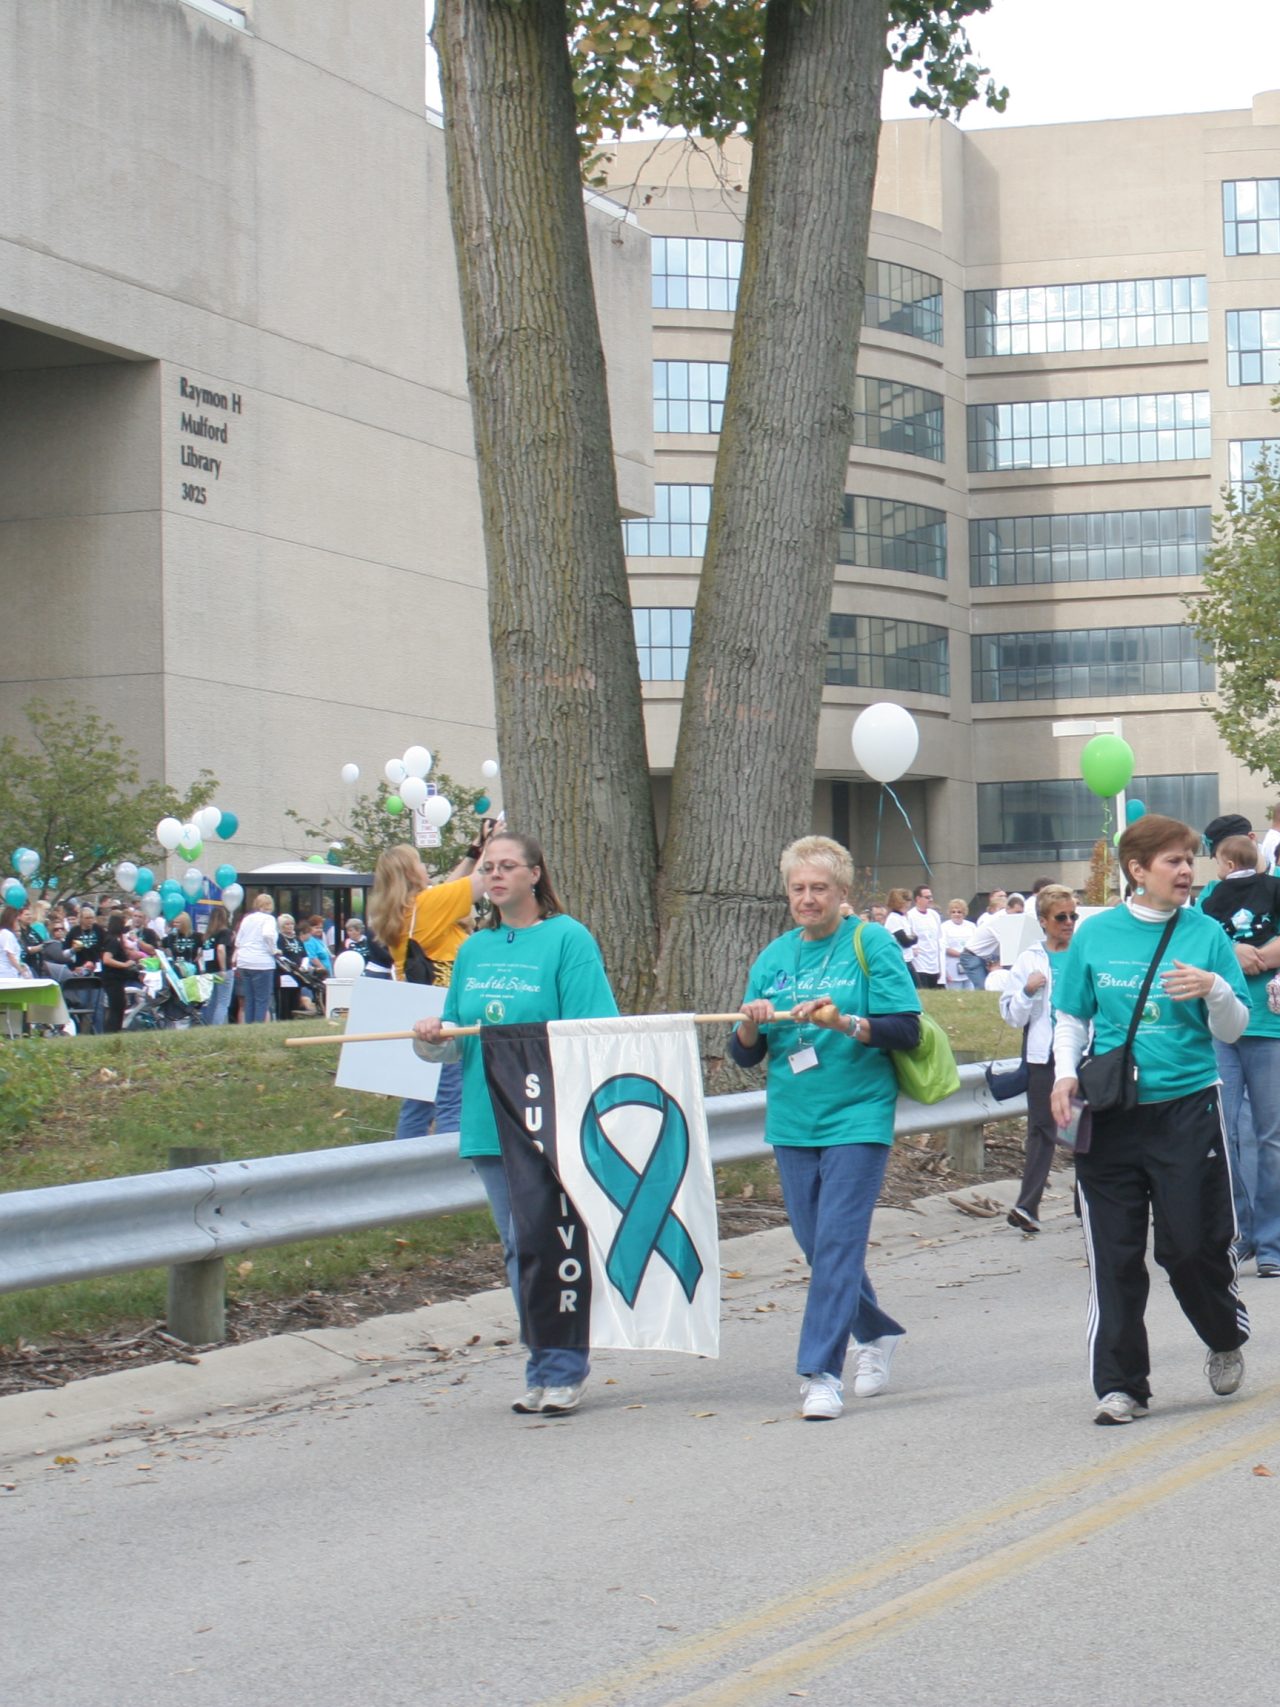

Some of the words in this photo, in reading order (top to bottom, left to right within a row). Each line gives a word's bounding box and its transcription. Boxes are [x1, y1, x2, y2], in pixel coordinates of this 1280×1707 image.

[180, 376, 228, 410] Raymon
[232, 393, 242, 414] H
[181, 412, 228, 443] Mulford
[181, 445, 222, 480] Library
[181, 482, 207, 505] 3025
[1097, 973, 1139, 988] Break
[525, 1073, 582, 1313] SUIVOR
